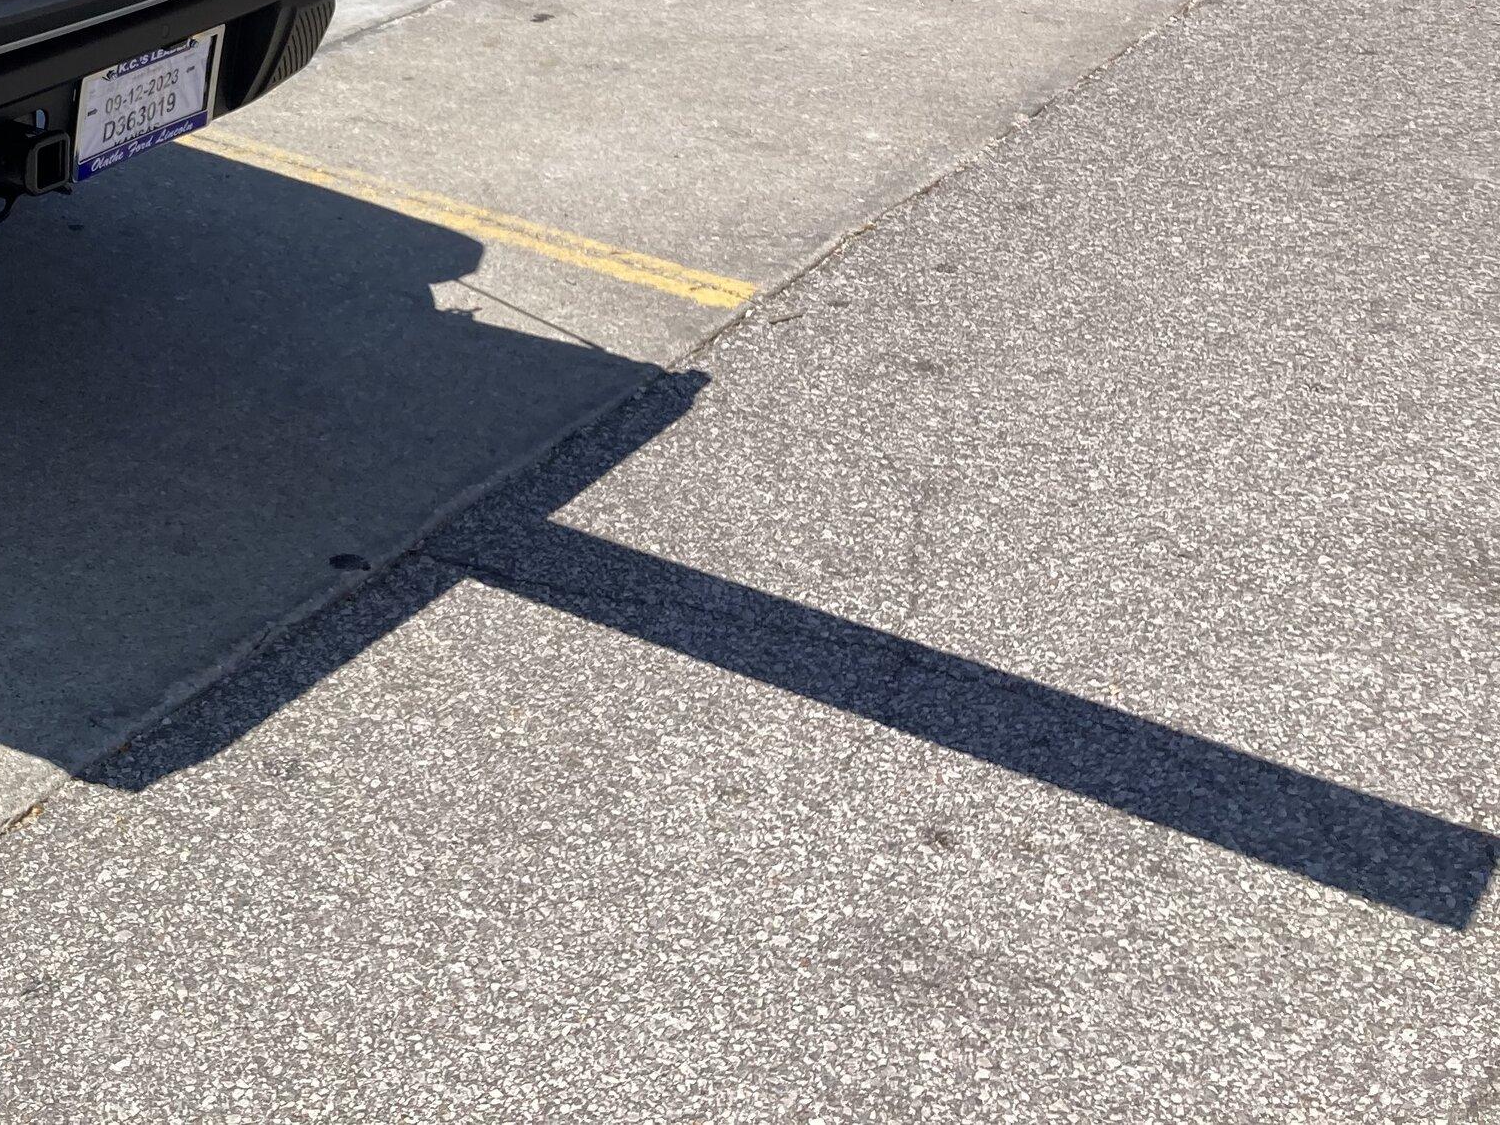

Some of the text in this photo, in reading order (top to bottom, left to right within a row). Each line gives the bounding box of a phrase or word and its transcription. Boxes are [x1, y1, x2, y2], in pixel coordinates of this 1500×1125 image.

[105, 68, 179, 114] 09-12-2023
[102, 92, 177, 143] D363019
[128, 137, 151, 158] Ford
[155, 120, 194, 144] Lincoln
